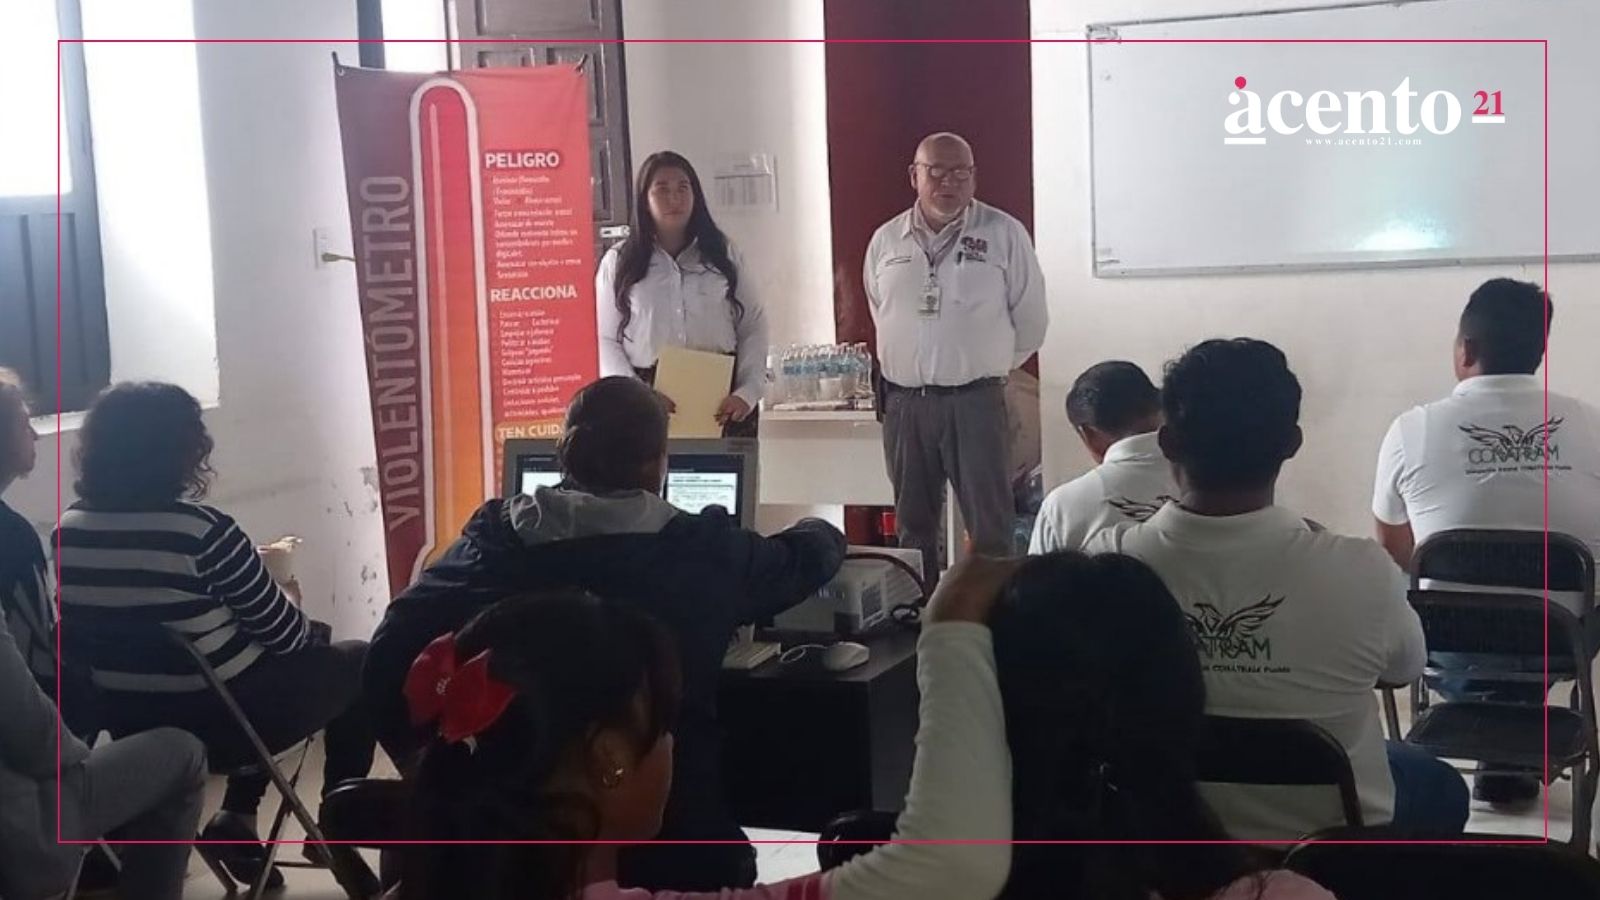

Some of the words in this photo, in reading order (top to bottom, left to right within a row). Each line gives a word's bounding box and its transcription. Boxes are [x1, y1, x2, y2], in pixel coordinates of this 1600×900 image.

[485, 151, 560, 169] PELIGRO
[490, 284, 578, 303] REACCIONA
[360, 176, 421, 531] VIOLENTÓMETRO
[498, 426, 525, 438] TEN
[528, 424, 561, 437] CUID
